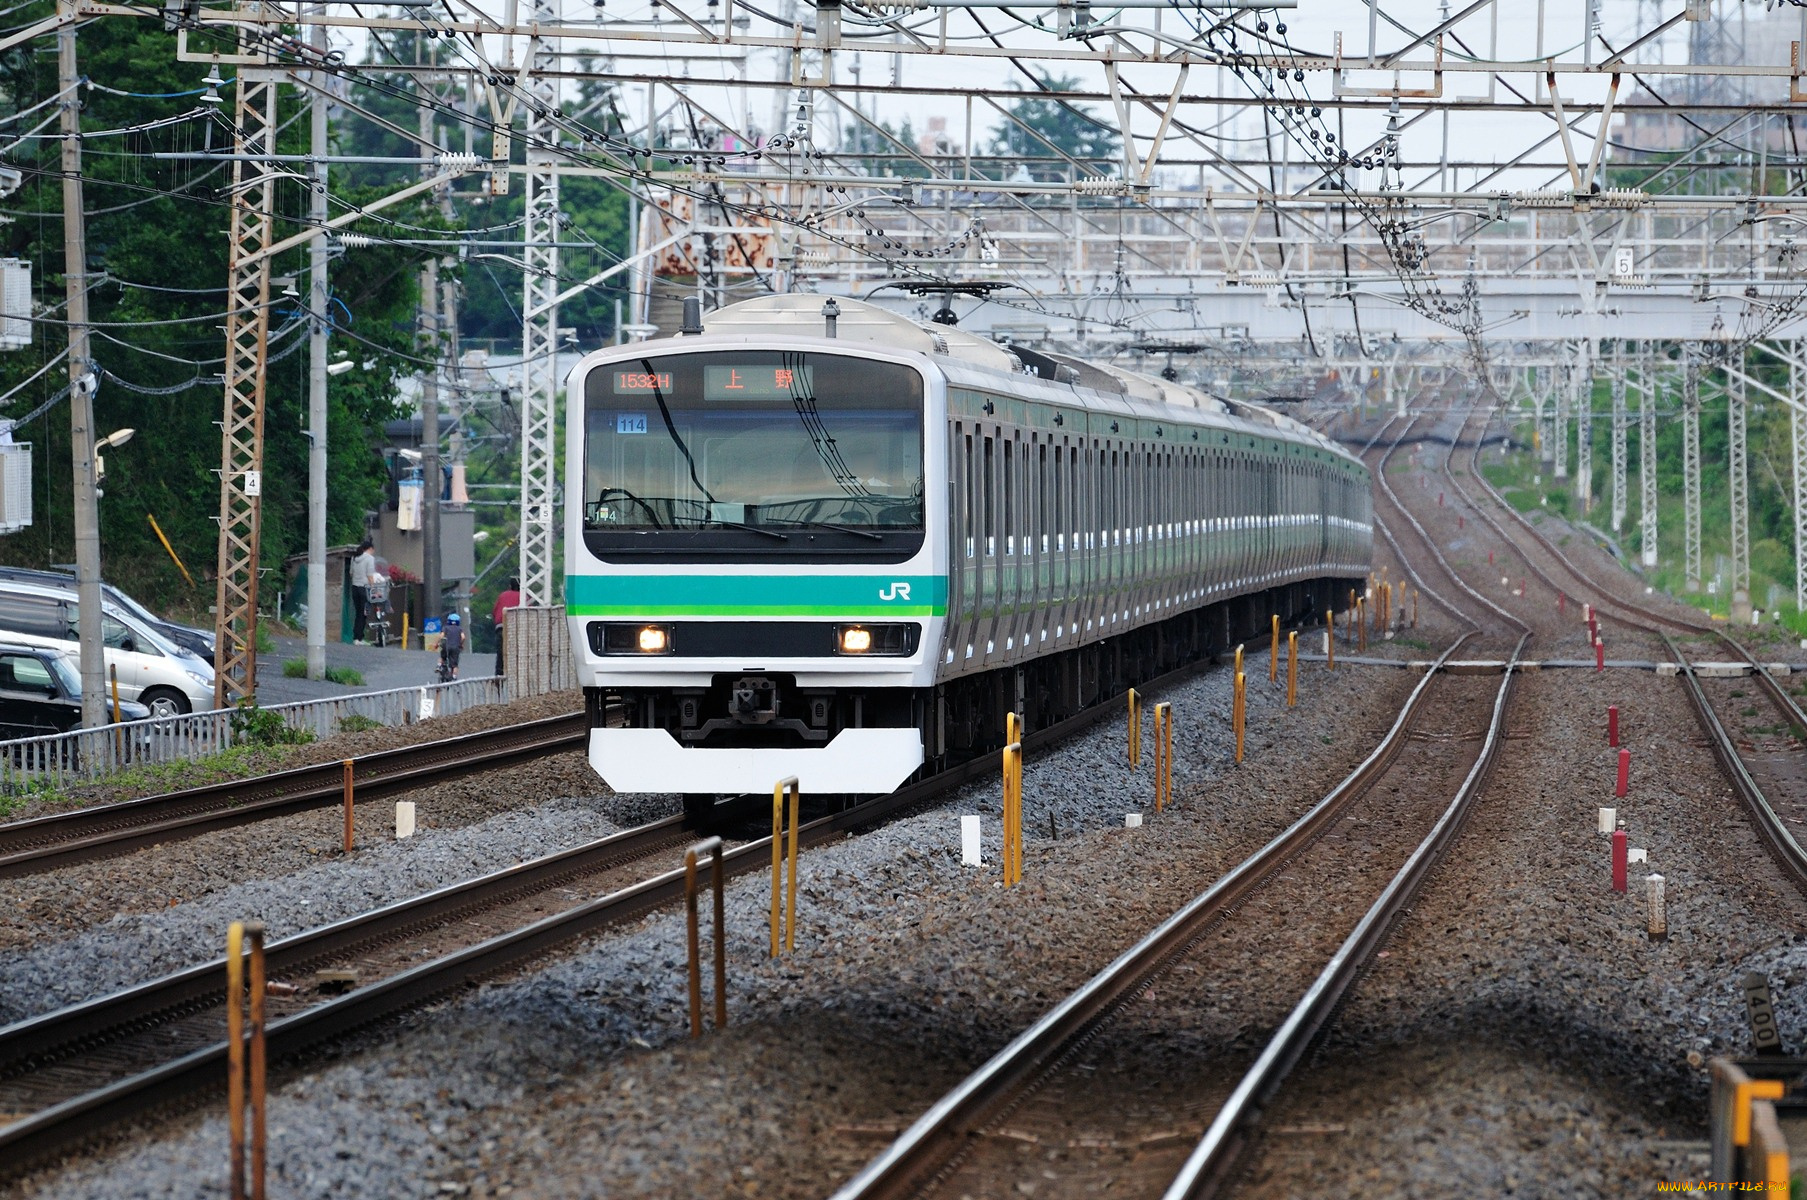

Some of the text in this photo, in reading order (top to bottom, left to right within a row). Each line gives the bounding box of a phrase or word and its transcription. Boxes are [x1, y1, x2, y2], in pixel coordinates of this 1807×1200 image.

[1620, 258, 1628, 273] 5
[620, 374, 670, 389] 1532H
[620, 418, 645, 432] 114
[249, 479, 256, 487] 4
[595, 511, 617, 522] 14
[879, 582, 911, 601] JR
[1746, 985, 1775, 1041] 1400
